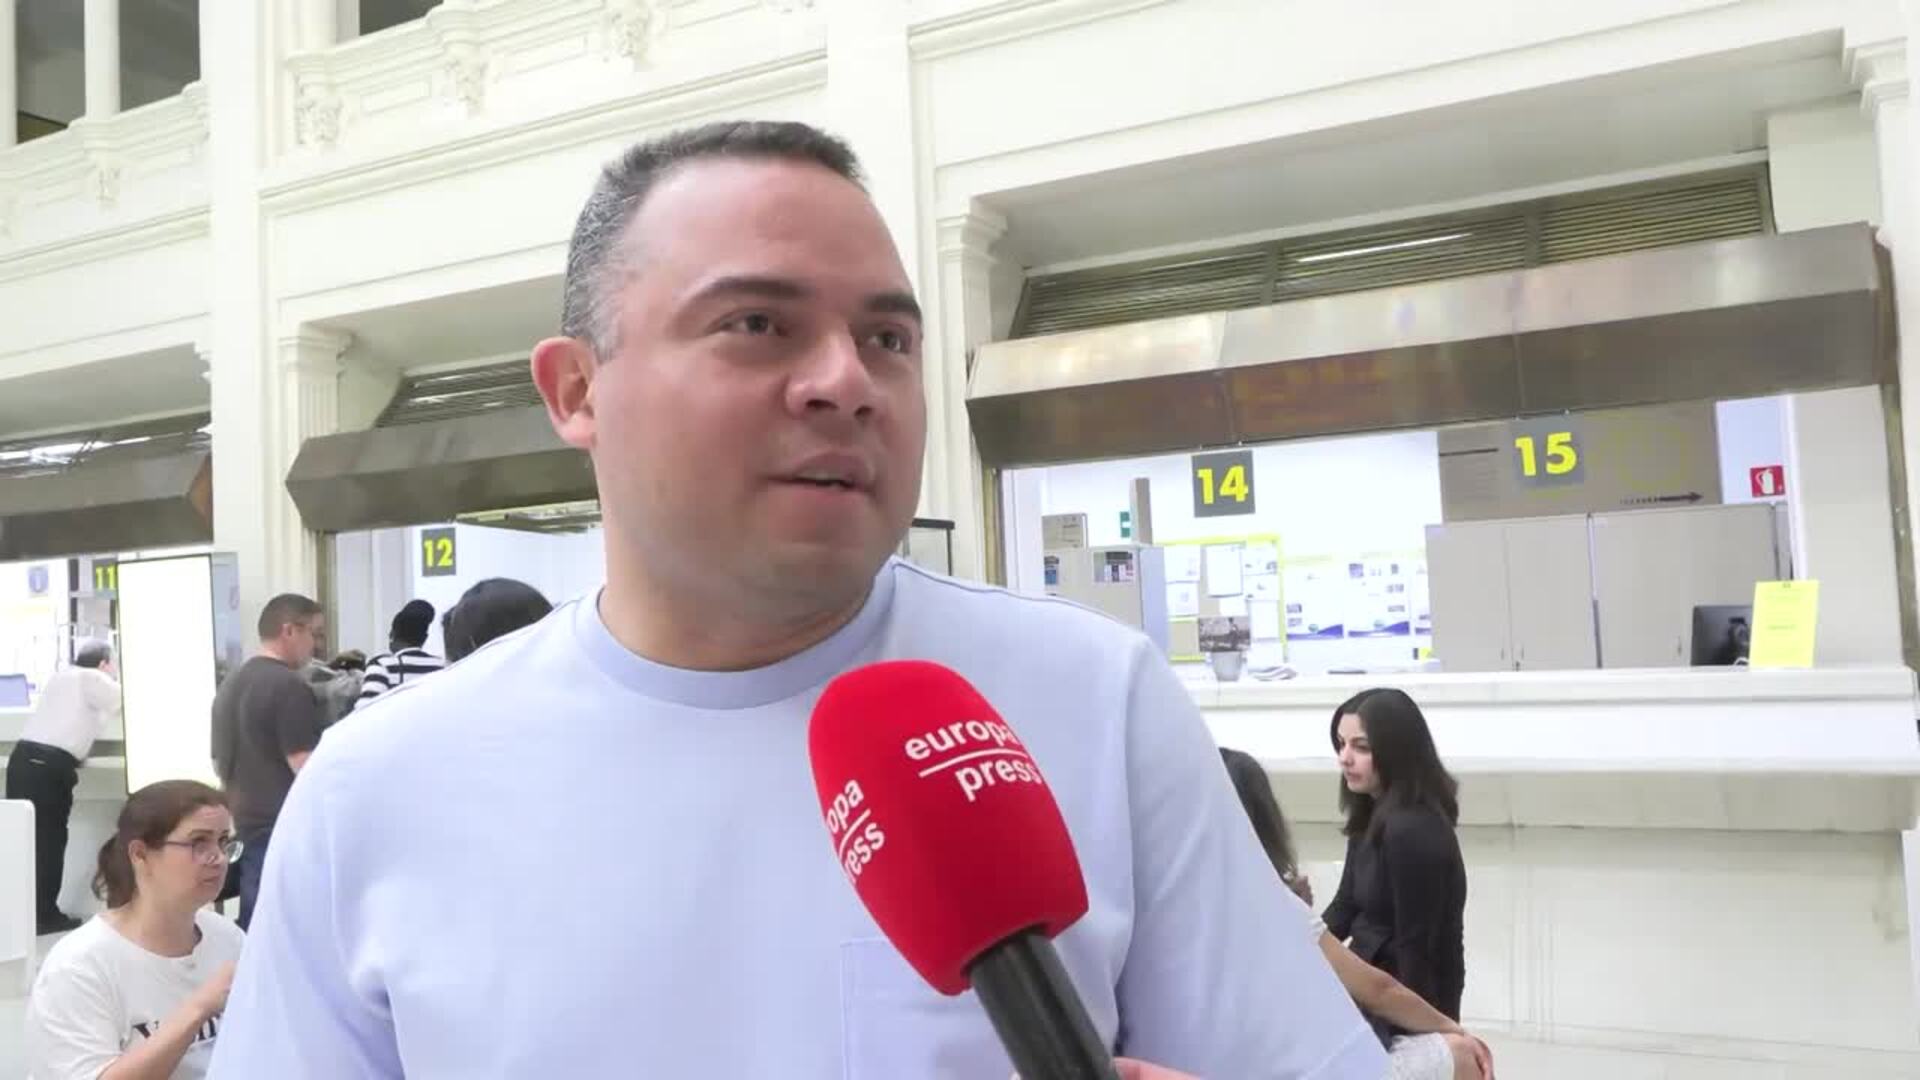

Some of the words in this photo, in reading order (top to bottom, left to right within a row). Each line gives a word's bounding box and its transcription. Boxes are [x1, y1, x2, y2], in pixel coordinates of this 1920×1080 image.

[1515, 431, 1578, 477] 15
[1197, 464, 1250, 506] 14
[423, 538, 454, 567] 12
[95, 564, 116, 592] 11
